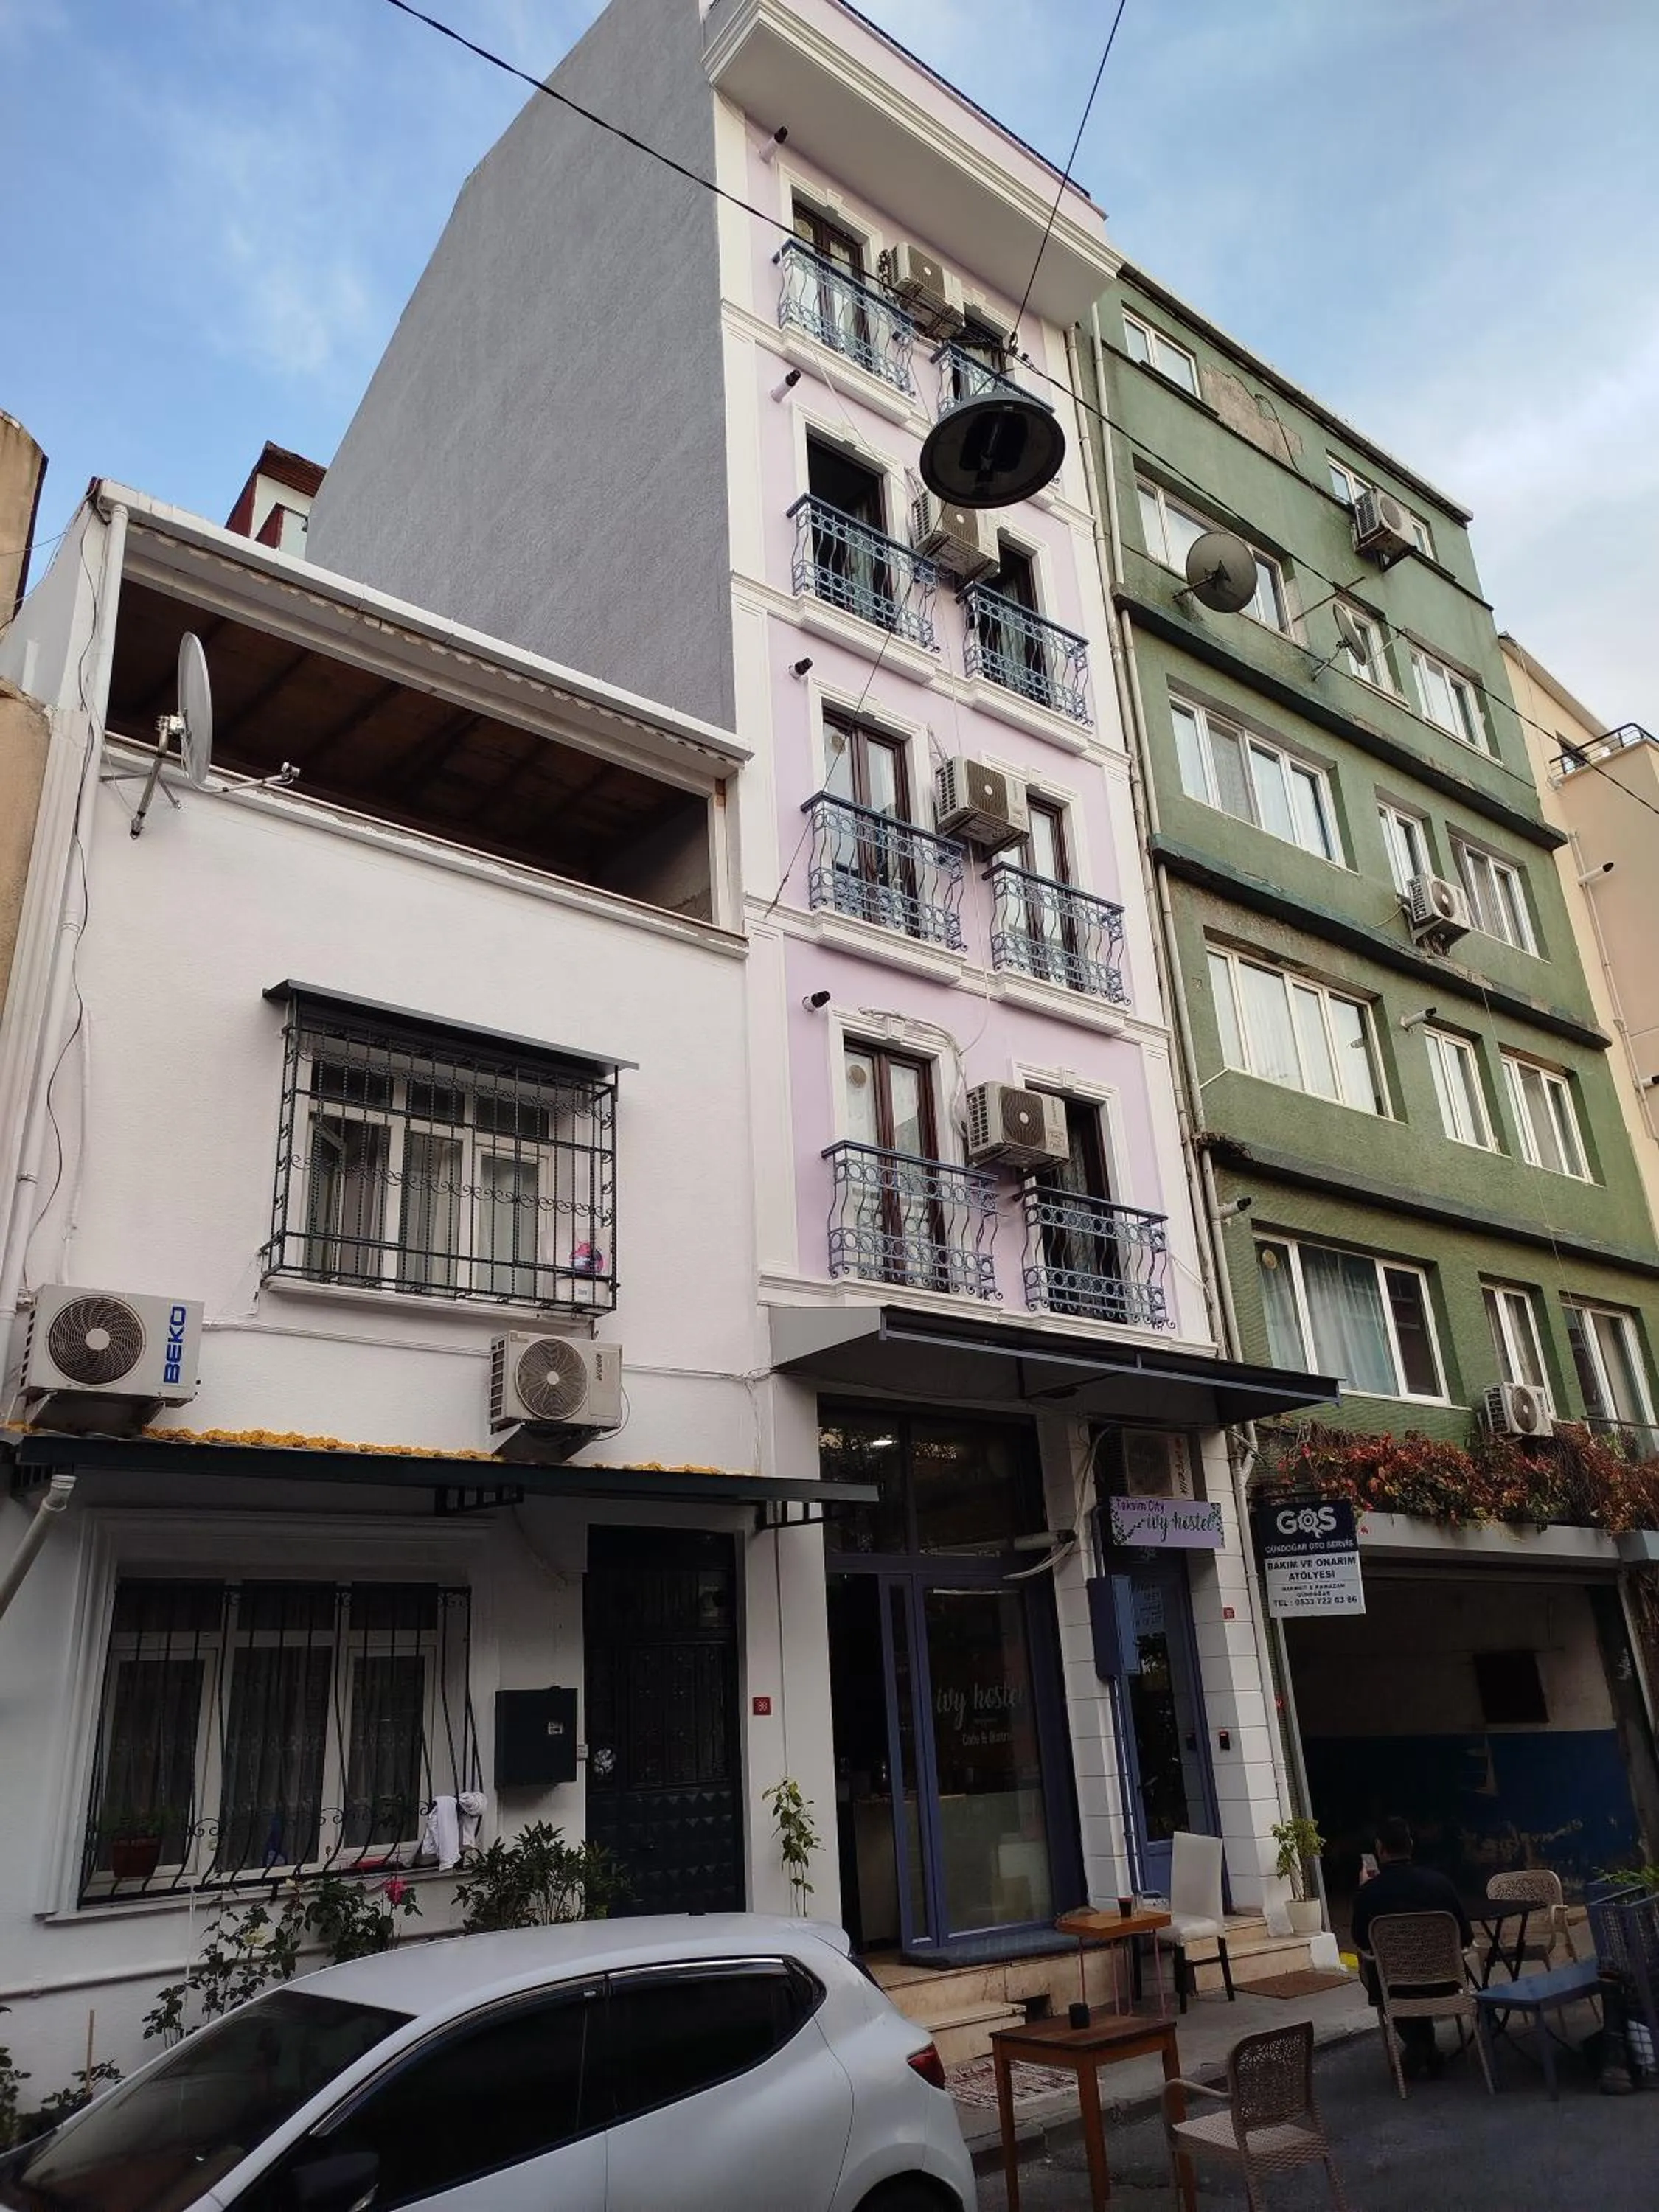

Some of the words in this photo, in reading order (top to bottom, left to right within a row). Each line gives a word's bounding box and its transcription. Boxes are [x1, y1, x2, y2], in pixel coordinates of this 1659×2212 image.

[164, 1306, 186, 1383] BEKO
[1116, 1499, 1147, 1511] Taksim
[1148, 1500, 1164, 1514] City
[1147, 1513, 1168, 1542] ivy
[1172, 1512, 1215, 1531] hostel
[1309, 1542, 1325, 1550] OTO
[1267, 1559, 1298, 1571] BAKIM
[1301, 1559, 1313, 1568] VE
[1316, 1557, 1355, 1567] ONARIM
[1288, 1570, 1335, 1581] ATÖLYESİ
[936, 1688, 966, 1730] ivy
[974, 1681, 1023, 1709] hostel
